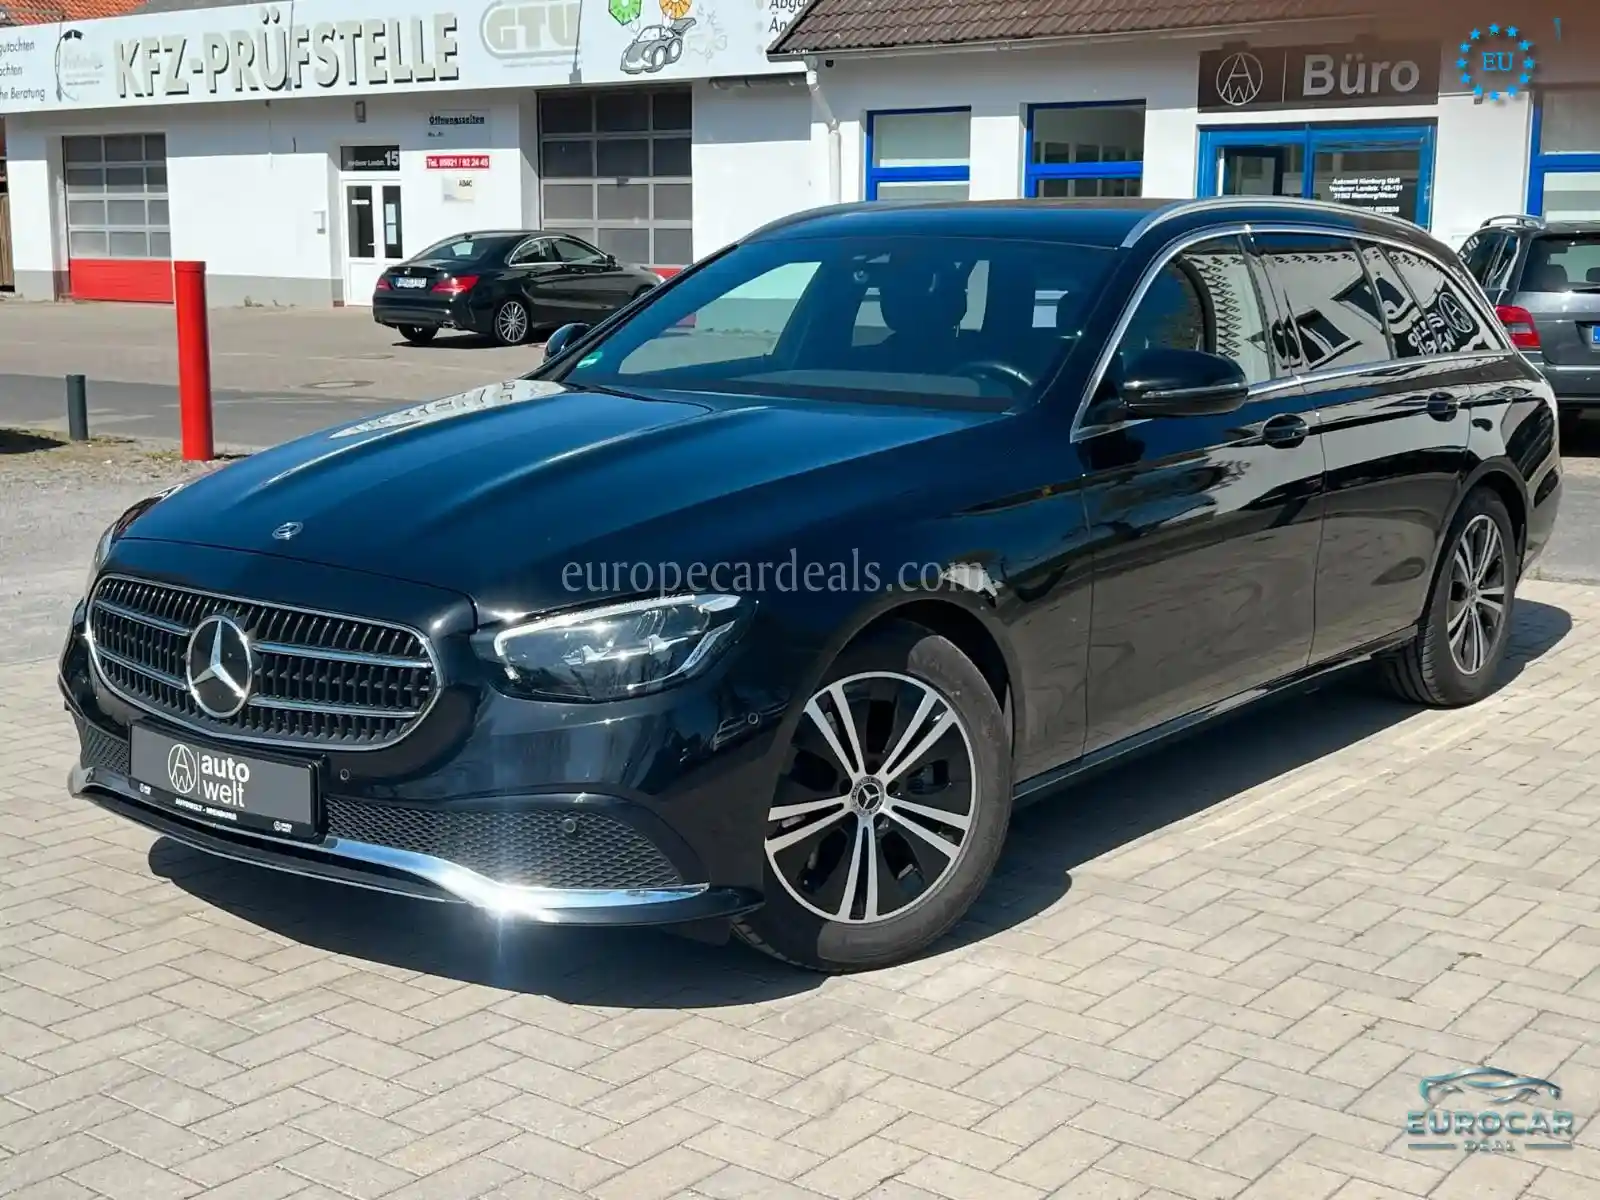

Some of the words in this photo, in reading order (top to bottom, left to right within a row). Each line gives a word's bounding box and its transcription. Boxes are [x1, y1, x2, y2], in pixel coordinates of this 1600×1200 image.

[113, 6, 459, 98] KFZ-PRÜFSTELLE
[1302, 53, 1420, 96] Büro
[11, 87, 45, 101] Beratung
[201, 754, 250, 783] auto
[202, 779, 246, 808] welt
